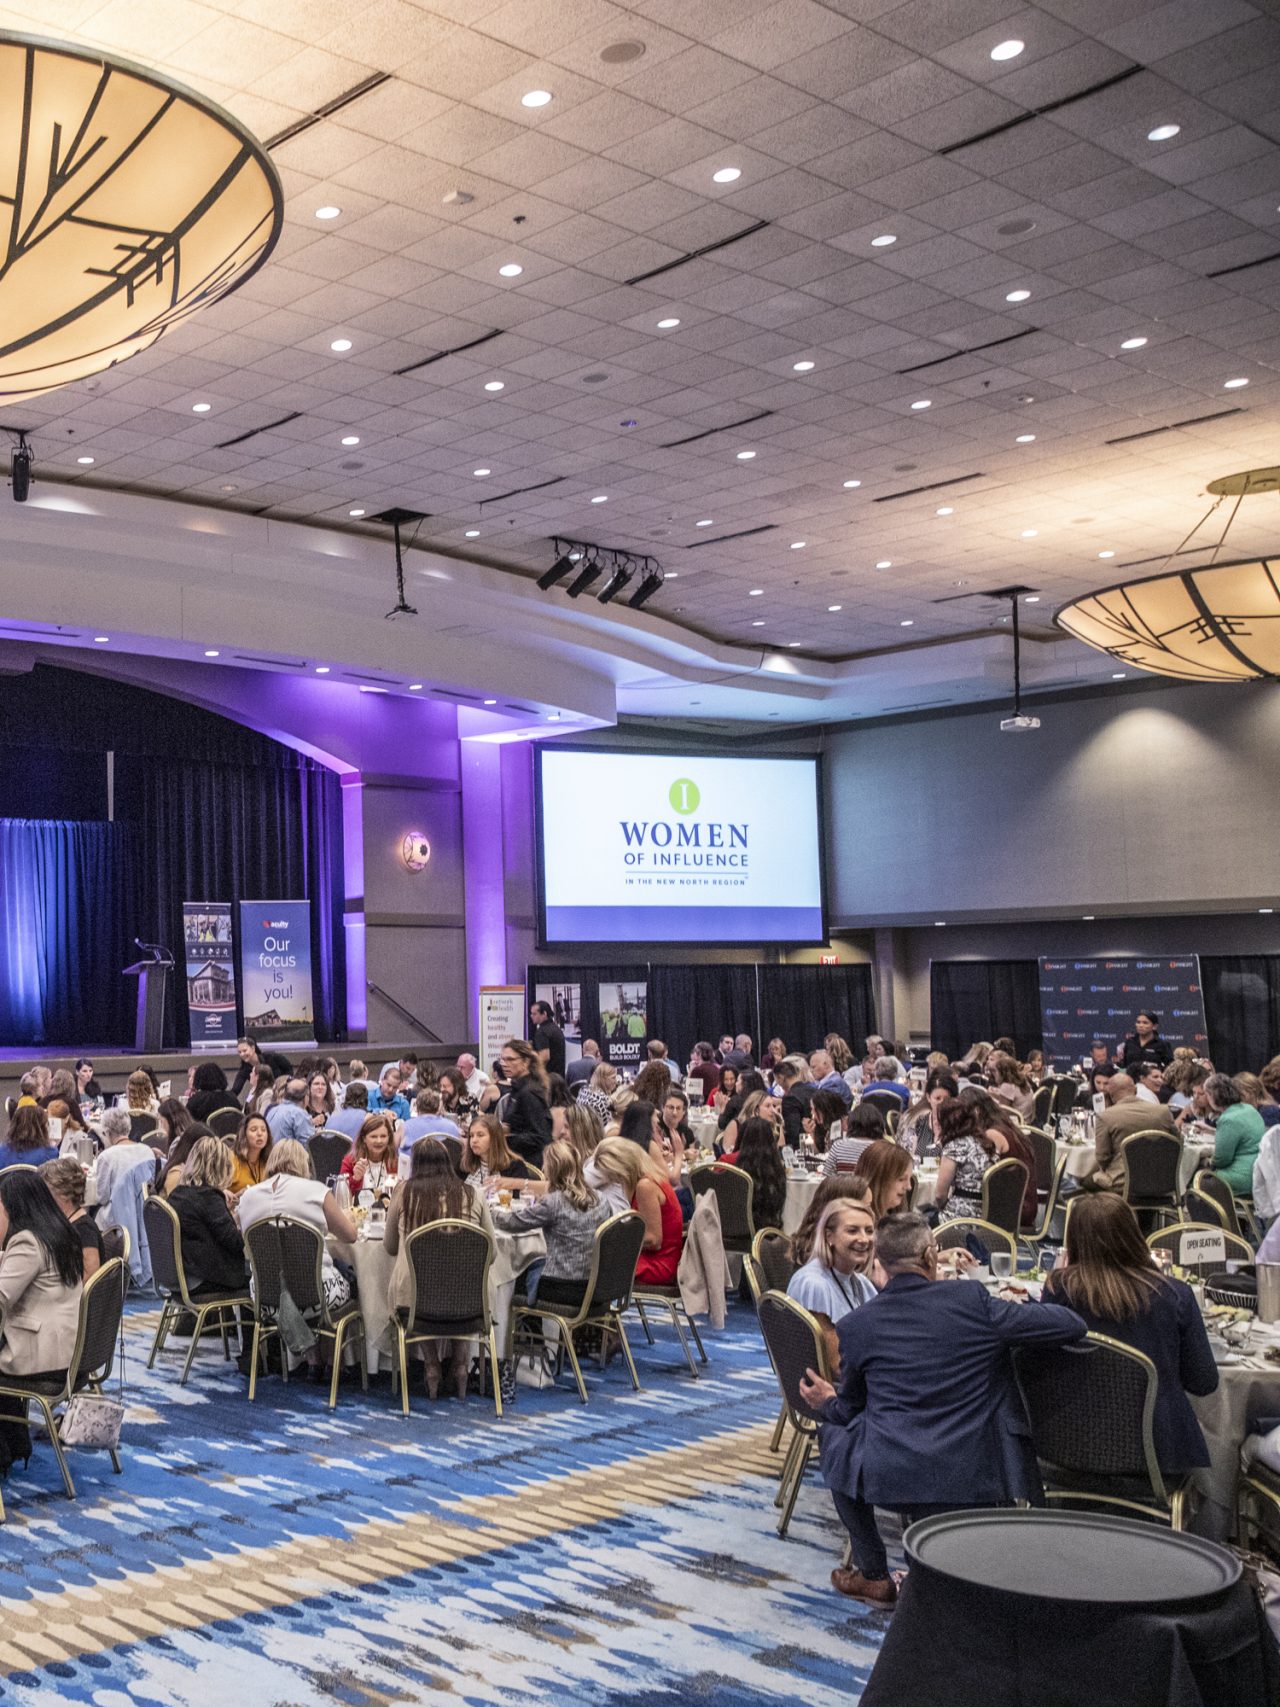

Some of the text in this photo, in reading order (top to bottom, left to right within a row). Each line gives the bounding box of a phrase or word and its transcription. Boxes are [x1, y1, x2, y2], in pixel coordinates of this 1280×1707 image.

[619, 821, 750, 848] WOMEN
[624, 852, 750, 867] OF INFLUENCE
[656, 878, 676, 886] NEW
[679, 878, 709, 886] NORTH
[263, 936, 290, 952] Our
[258, 953, 296, 967] focus
[273, 970, 284, 983] is
[264, 985, 293, 1002] you!
[487, 1015, 509, 1023] Creating
[609, 1043, 641, 1054] BOLDT
[1187, 1238, 1222, 1250] OPEN SEATING
